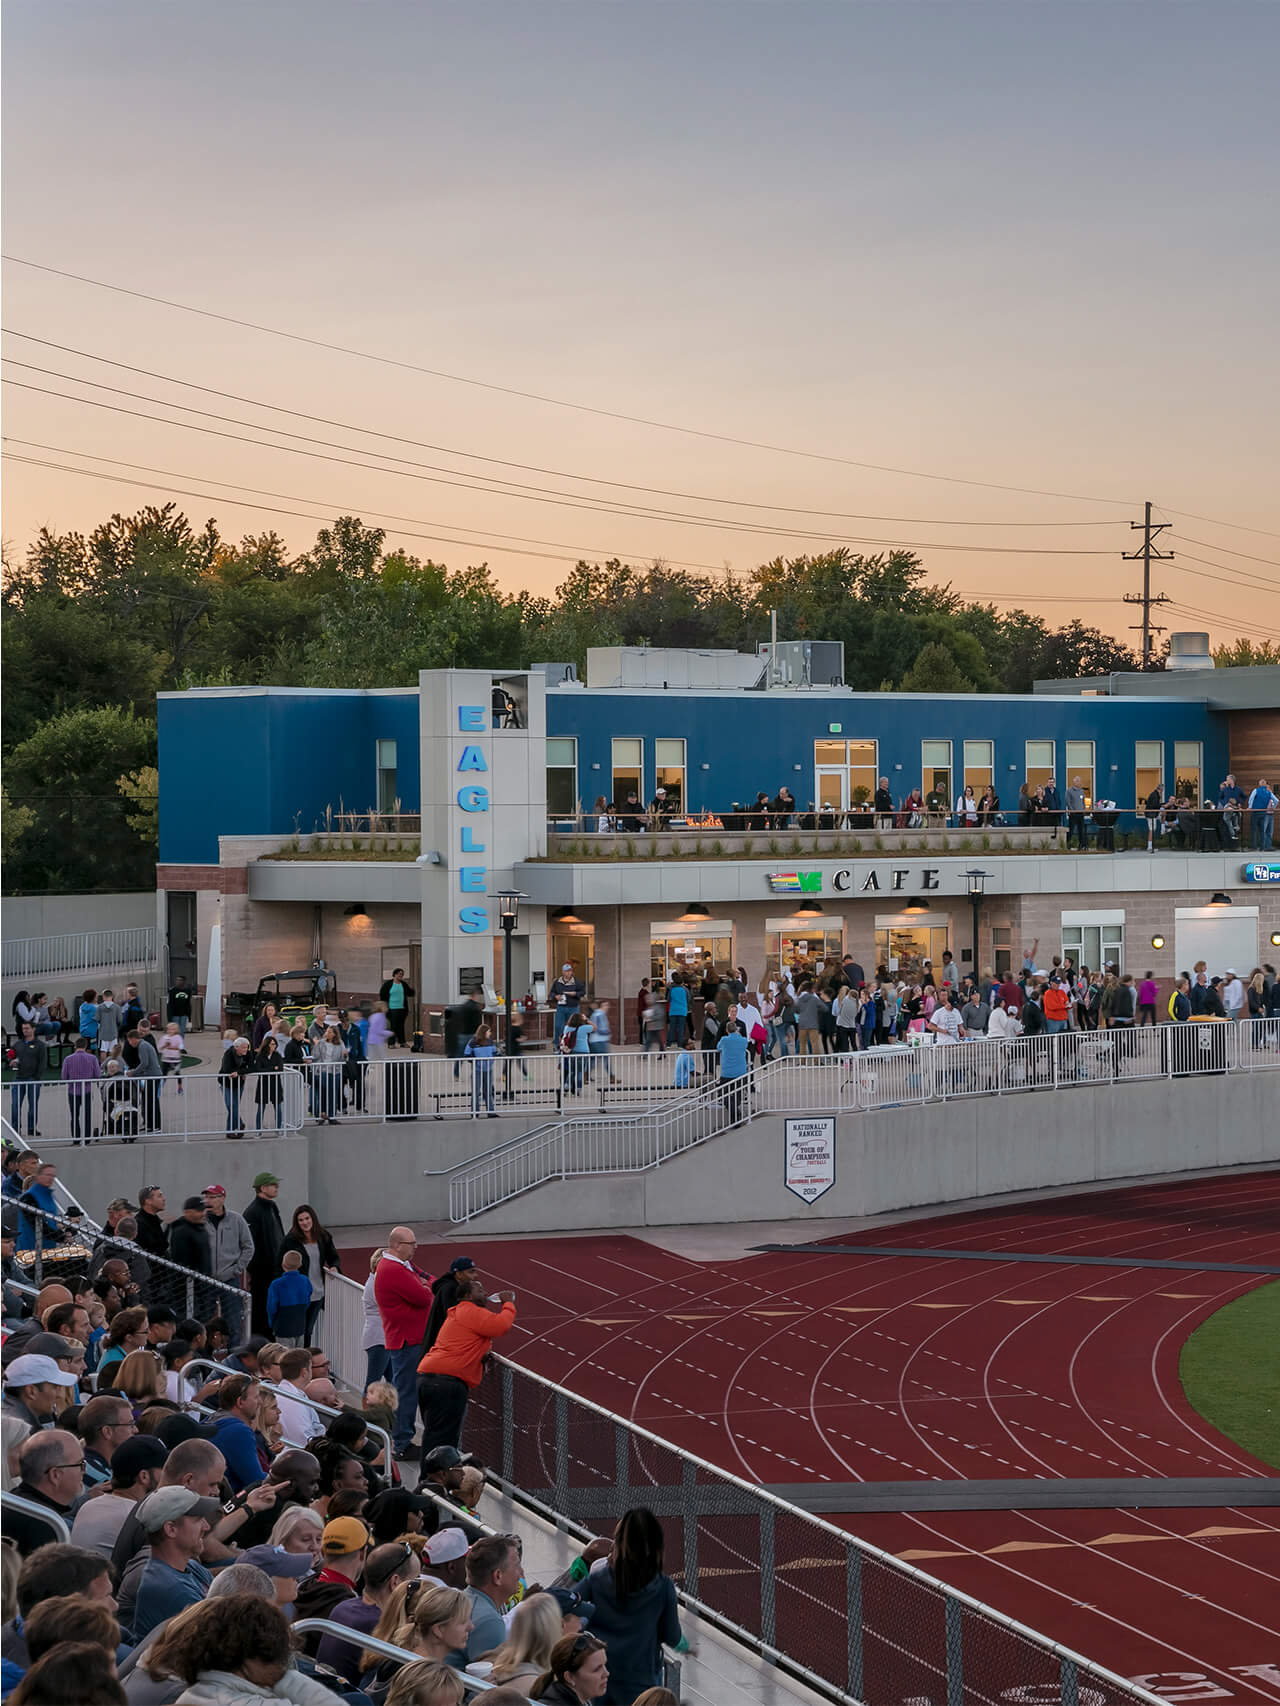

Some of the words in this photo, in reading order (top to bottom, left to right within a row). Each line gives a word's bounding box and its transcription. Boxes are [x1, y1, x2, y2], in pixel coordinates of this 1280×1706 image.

[457, 705, 489, 934] EAGLES
[832, 869, 940, 892] CAFE
[793, 1123, 827, 1131] NATIONALLY
[796, 1153, 830, 1161] CHAMPIONS
[803, 1187, 817, 1195] 2012
[1128, 1672, 1235, 1701] 5
